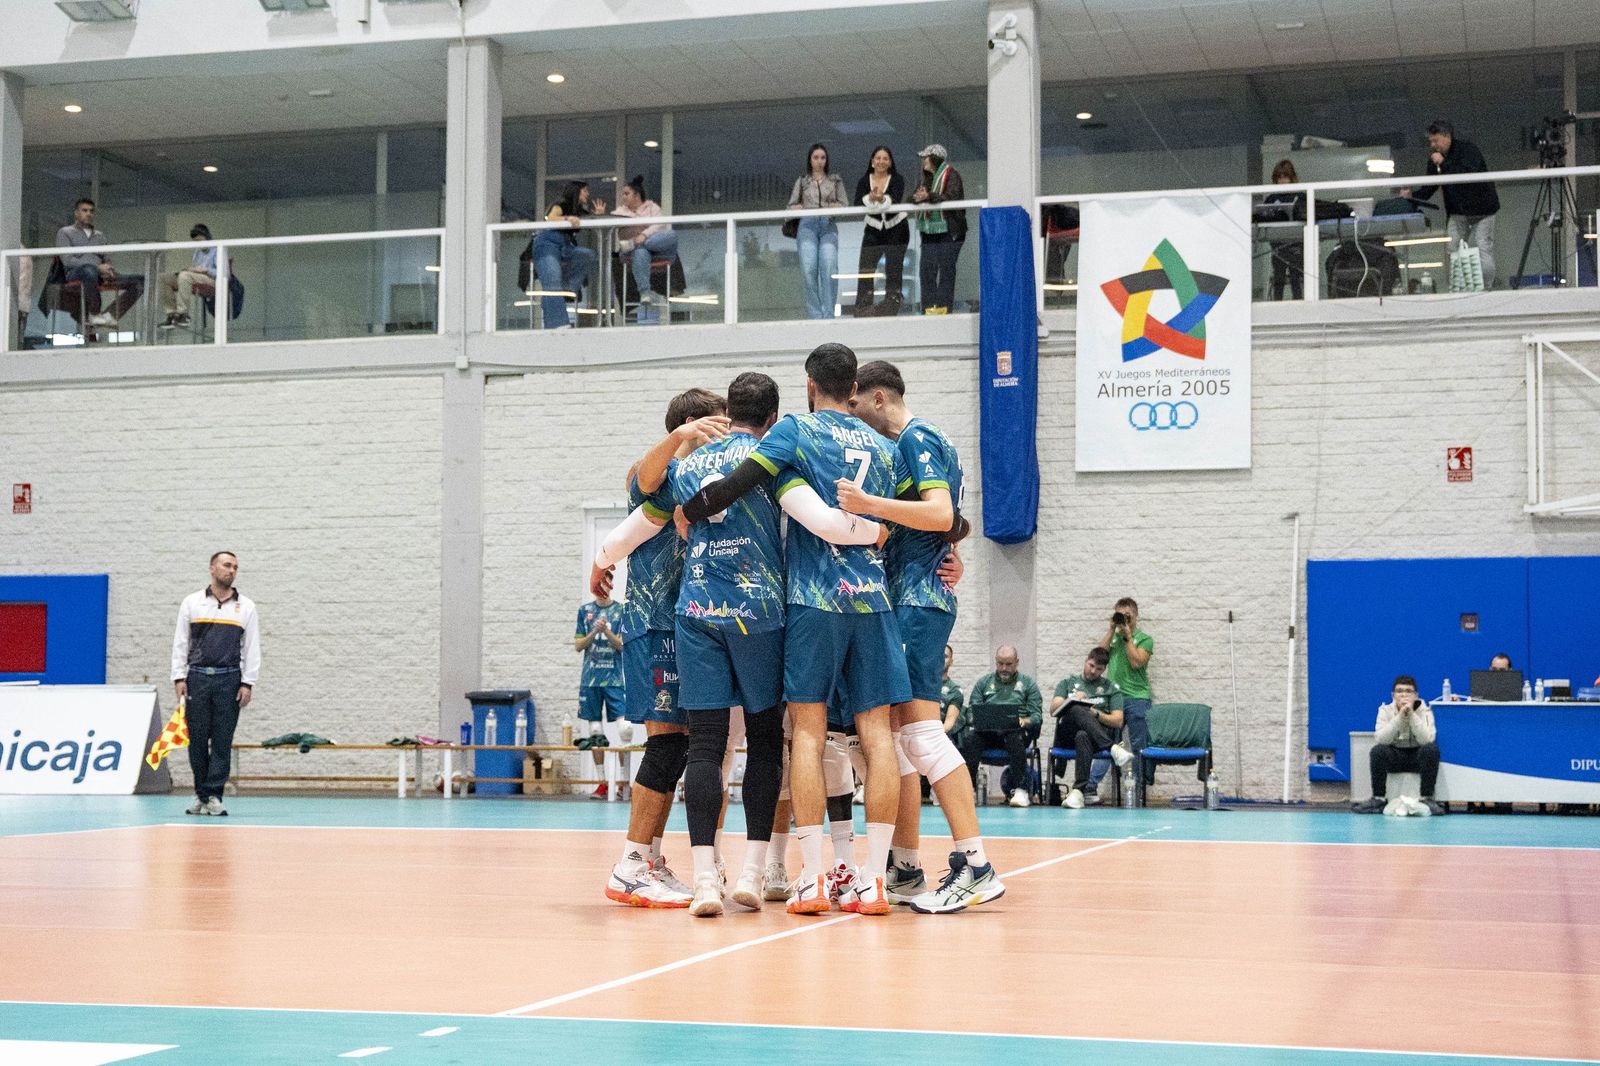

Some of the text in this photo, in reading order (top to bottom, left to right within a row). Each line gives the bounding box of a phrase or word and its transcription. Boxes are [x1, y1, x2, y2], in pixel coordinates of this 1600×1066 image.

[1097, 366, 1231, 381] XV Juegos Mediterráneos
[1097, 379, 1231, 398] Almería 2005
[844, 446, 872, 490] 7
[708, 545, 739, 557] Unicaja
[709, 536, 751, 549] Fundación
[685, 599, 758, 620] Andalucía
